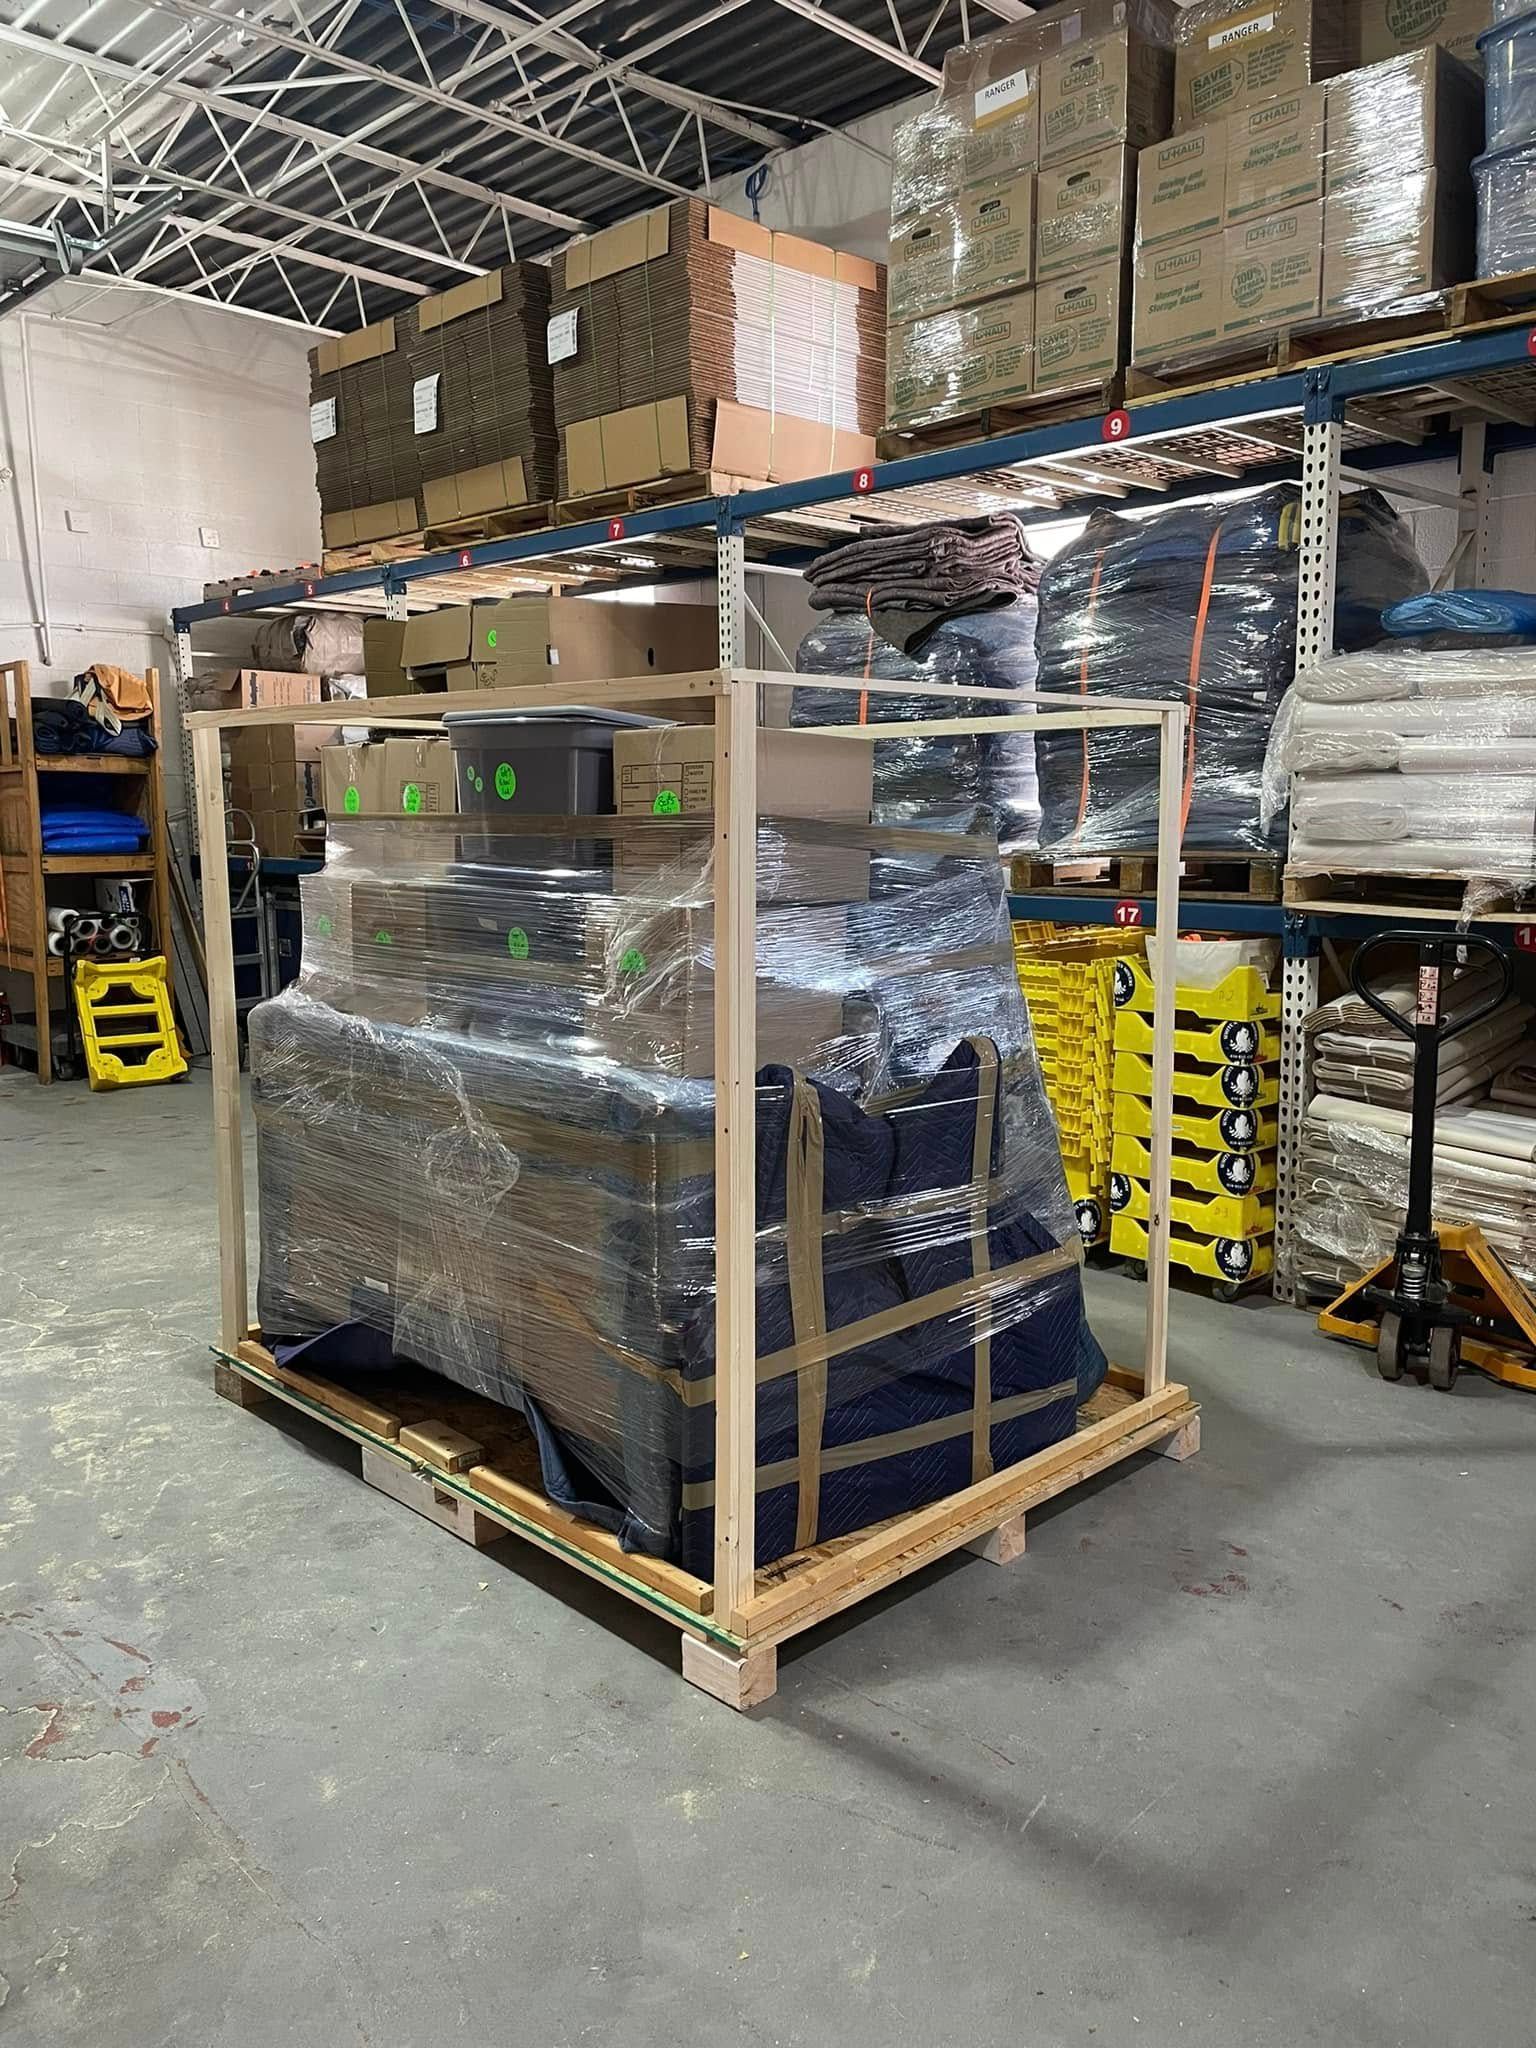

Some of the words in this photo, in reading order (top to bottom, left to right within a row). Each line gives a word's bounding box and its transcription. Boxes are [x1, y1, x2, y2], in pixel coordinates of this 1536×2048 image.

[1221, 23, 1259, 45] RANGER
[1193, 63, 1231, 92] SAVE!
[984, 78, 1016, 99] RANGER
[1252, 103, 1297, 126] U-HAUL
[1161, 140, 1201, 161] U-HAUL
[1060, 183, 1098, 201] U-HAUL
[974, 210, 1007, 228] U-HAUL
[1250, 221, 1295, 242] U-HAUL
[906, 239, 937, 255] U-HAUL
[1157, 251, 1199, 273] U-HAUL
[1057, 298, 1094, 315] U-HAUL
[1042, 329, 1069, 348] SAVE!
[1110, 418, 1122, 435] 9
[859, 473, 868, 488] 8
[613, 523, 620, 536] 7
[462, 555, 469, 566] 6
[307, 584, 313, 595] 5
[1116, 906, 1139, 923] 17
[1519, 927, 1536, 946] 1
